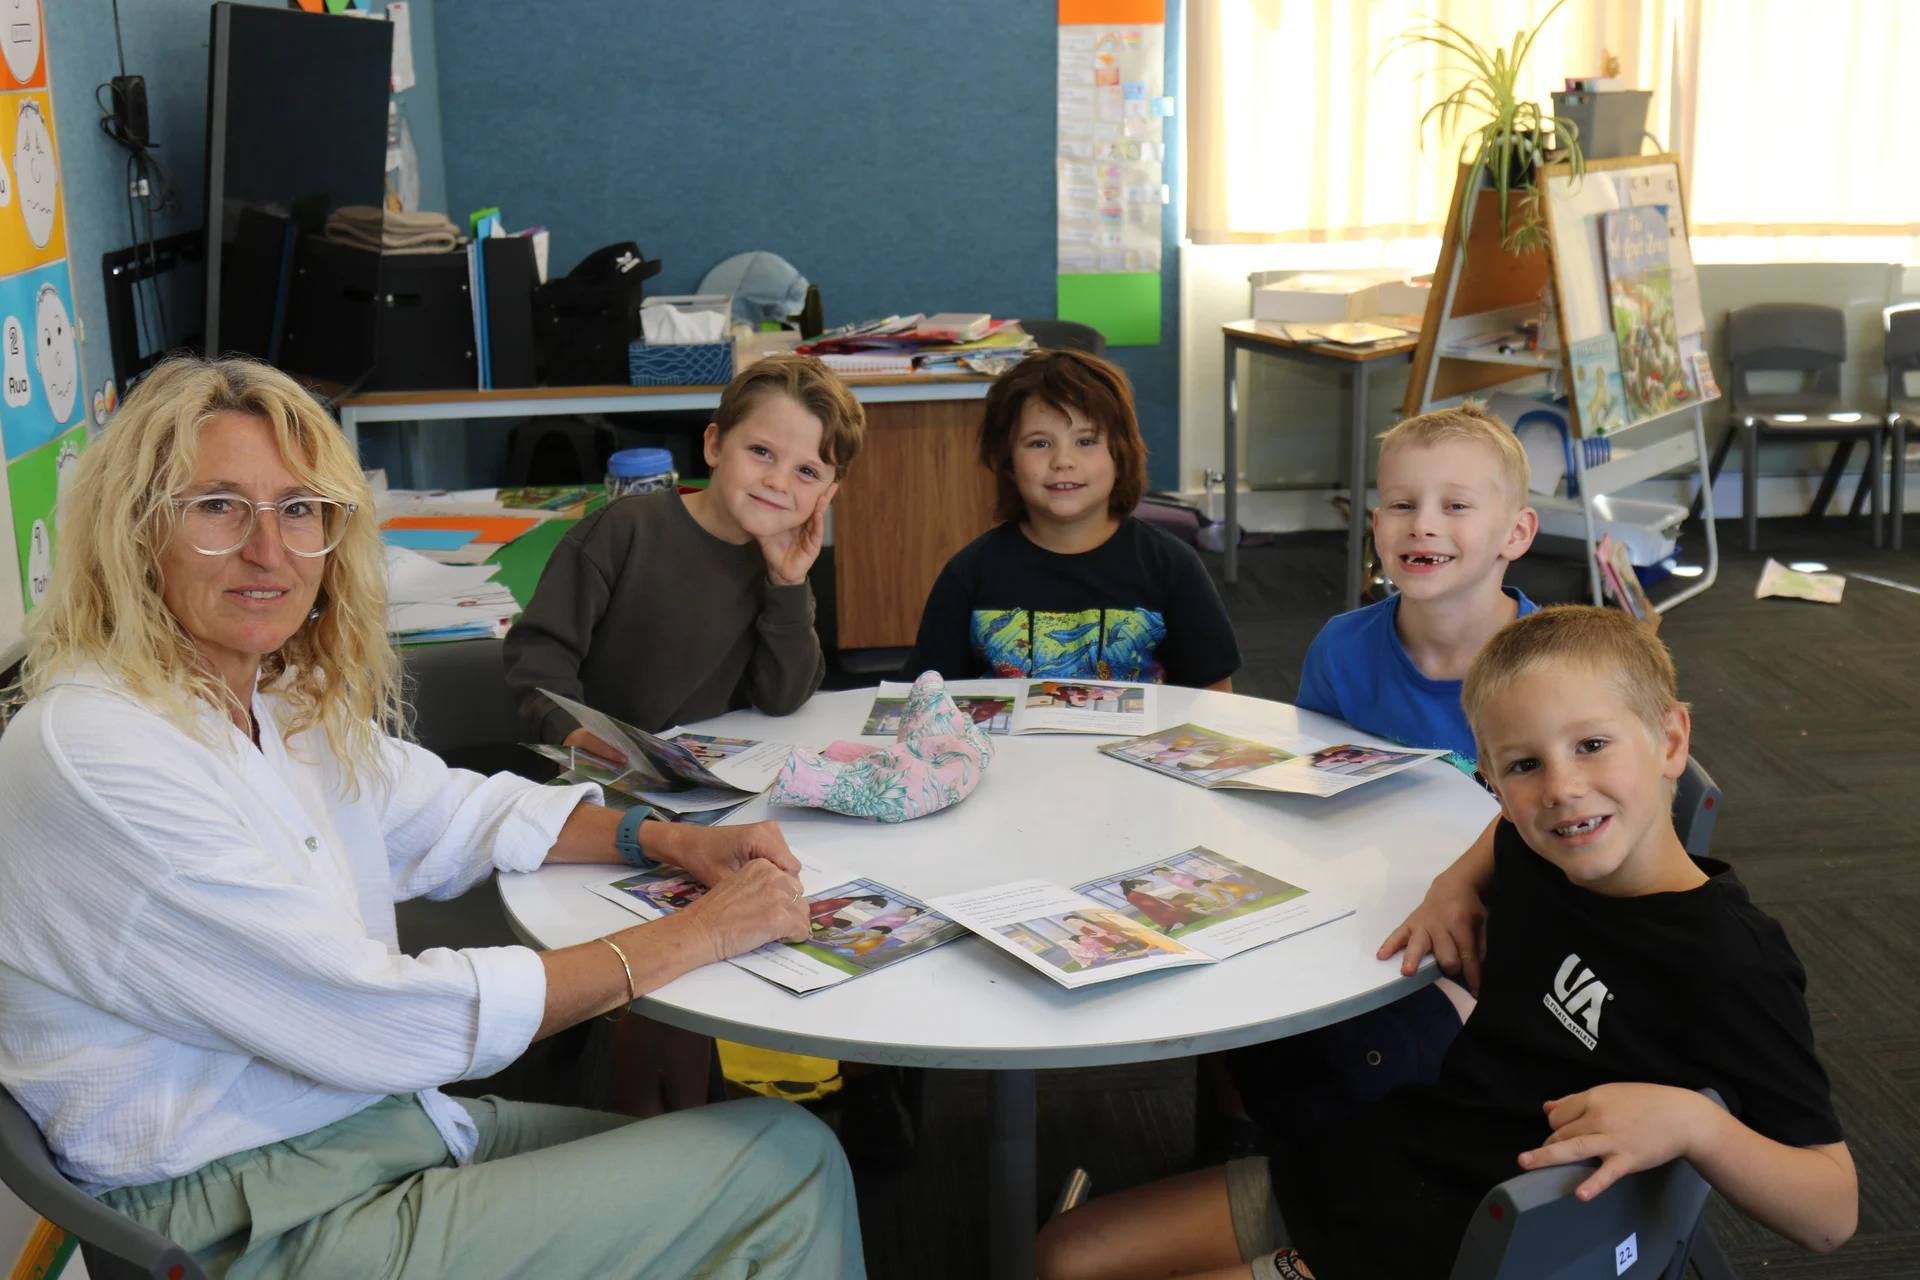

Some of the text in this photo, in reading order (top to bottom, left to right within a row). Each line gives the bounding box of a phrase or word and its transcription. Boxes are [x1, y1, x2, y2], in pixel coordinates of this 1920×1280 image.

[9, 326, 18, 355] 2
[9, 377, 27, 394] Rua
[33, 575, 48, 595] Tah
[1544, 995, 1596, 1049] ULTIMATE ATHLETE
[1619, 1246, 1633, 1265] 22
